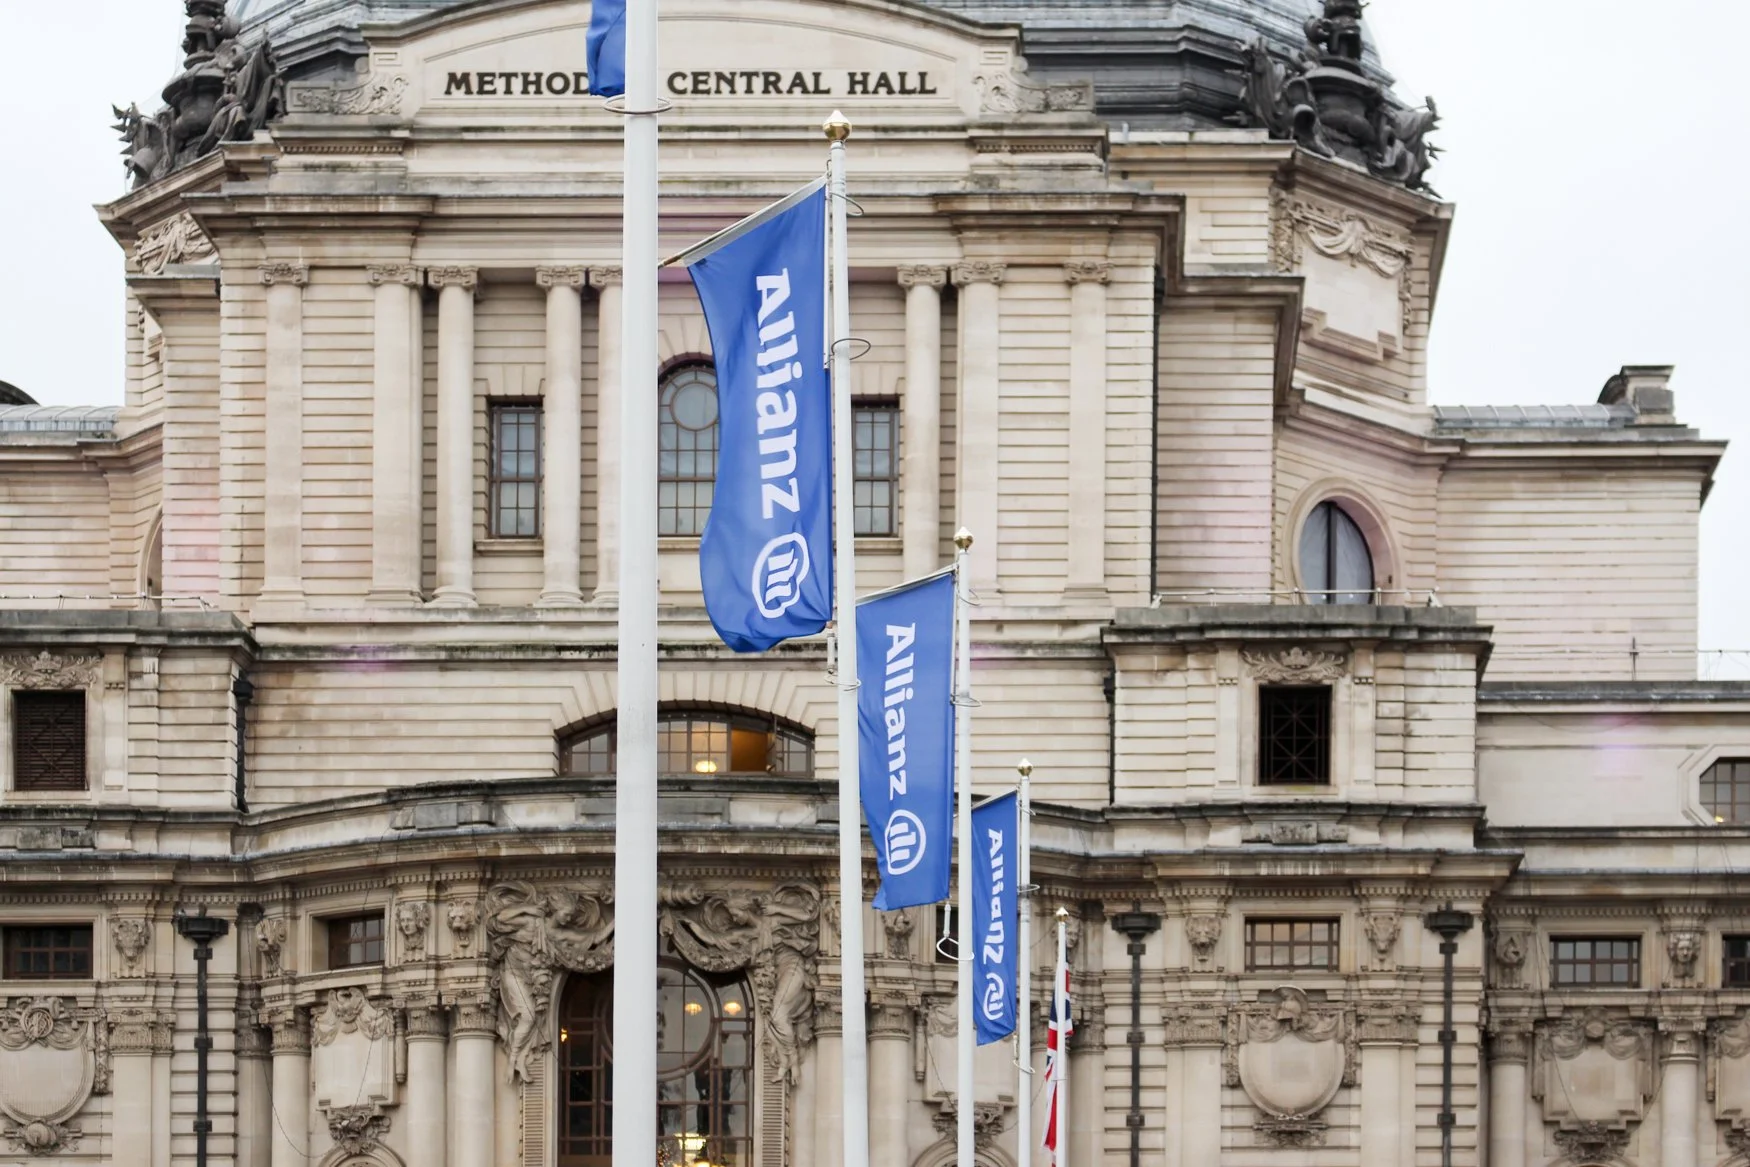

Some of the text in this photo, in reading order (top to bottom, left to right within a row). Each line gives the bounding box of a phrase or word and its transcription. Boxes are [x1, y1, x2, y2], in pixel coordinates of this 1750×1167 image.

[444, 71, 937, 95] METHOD CENTRAL HALL
[755, 267, 803, 520] Allianz
[883, 622, 916, 801] Allianz
[983, 828, 1005, 965] Allianz
